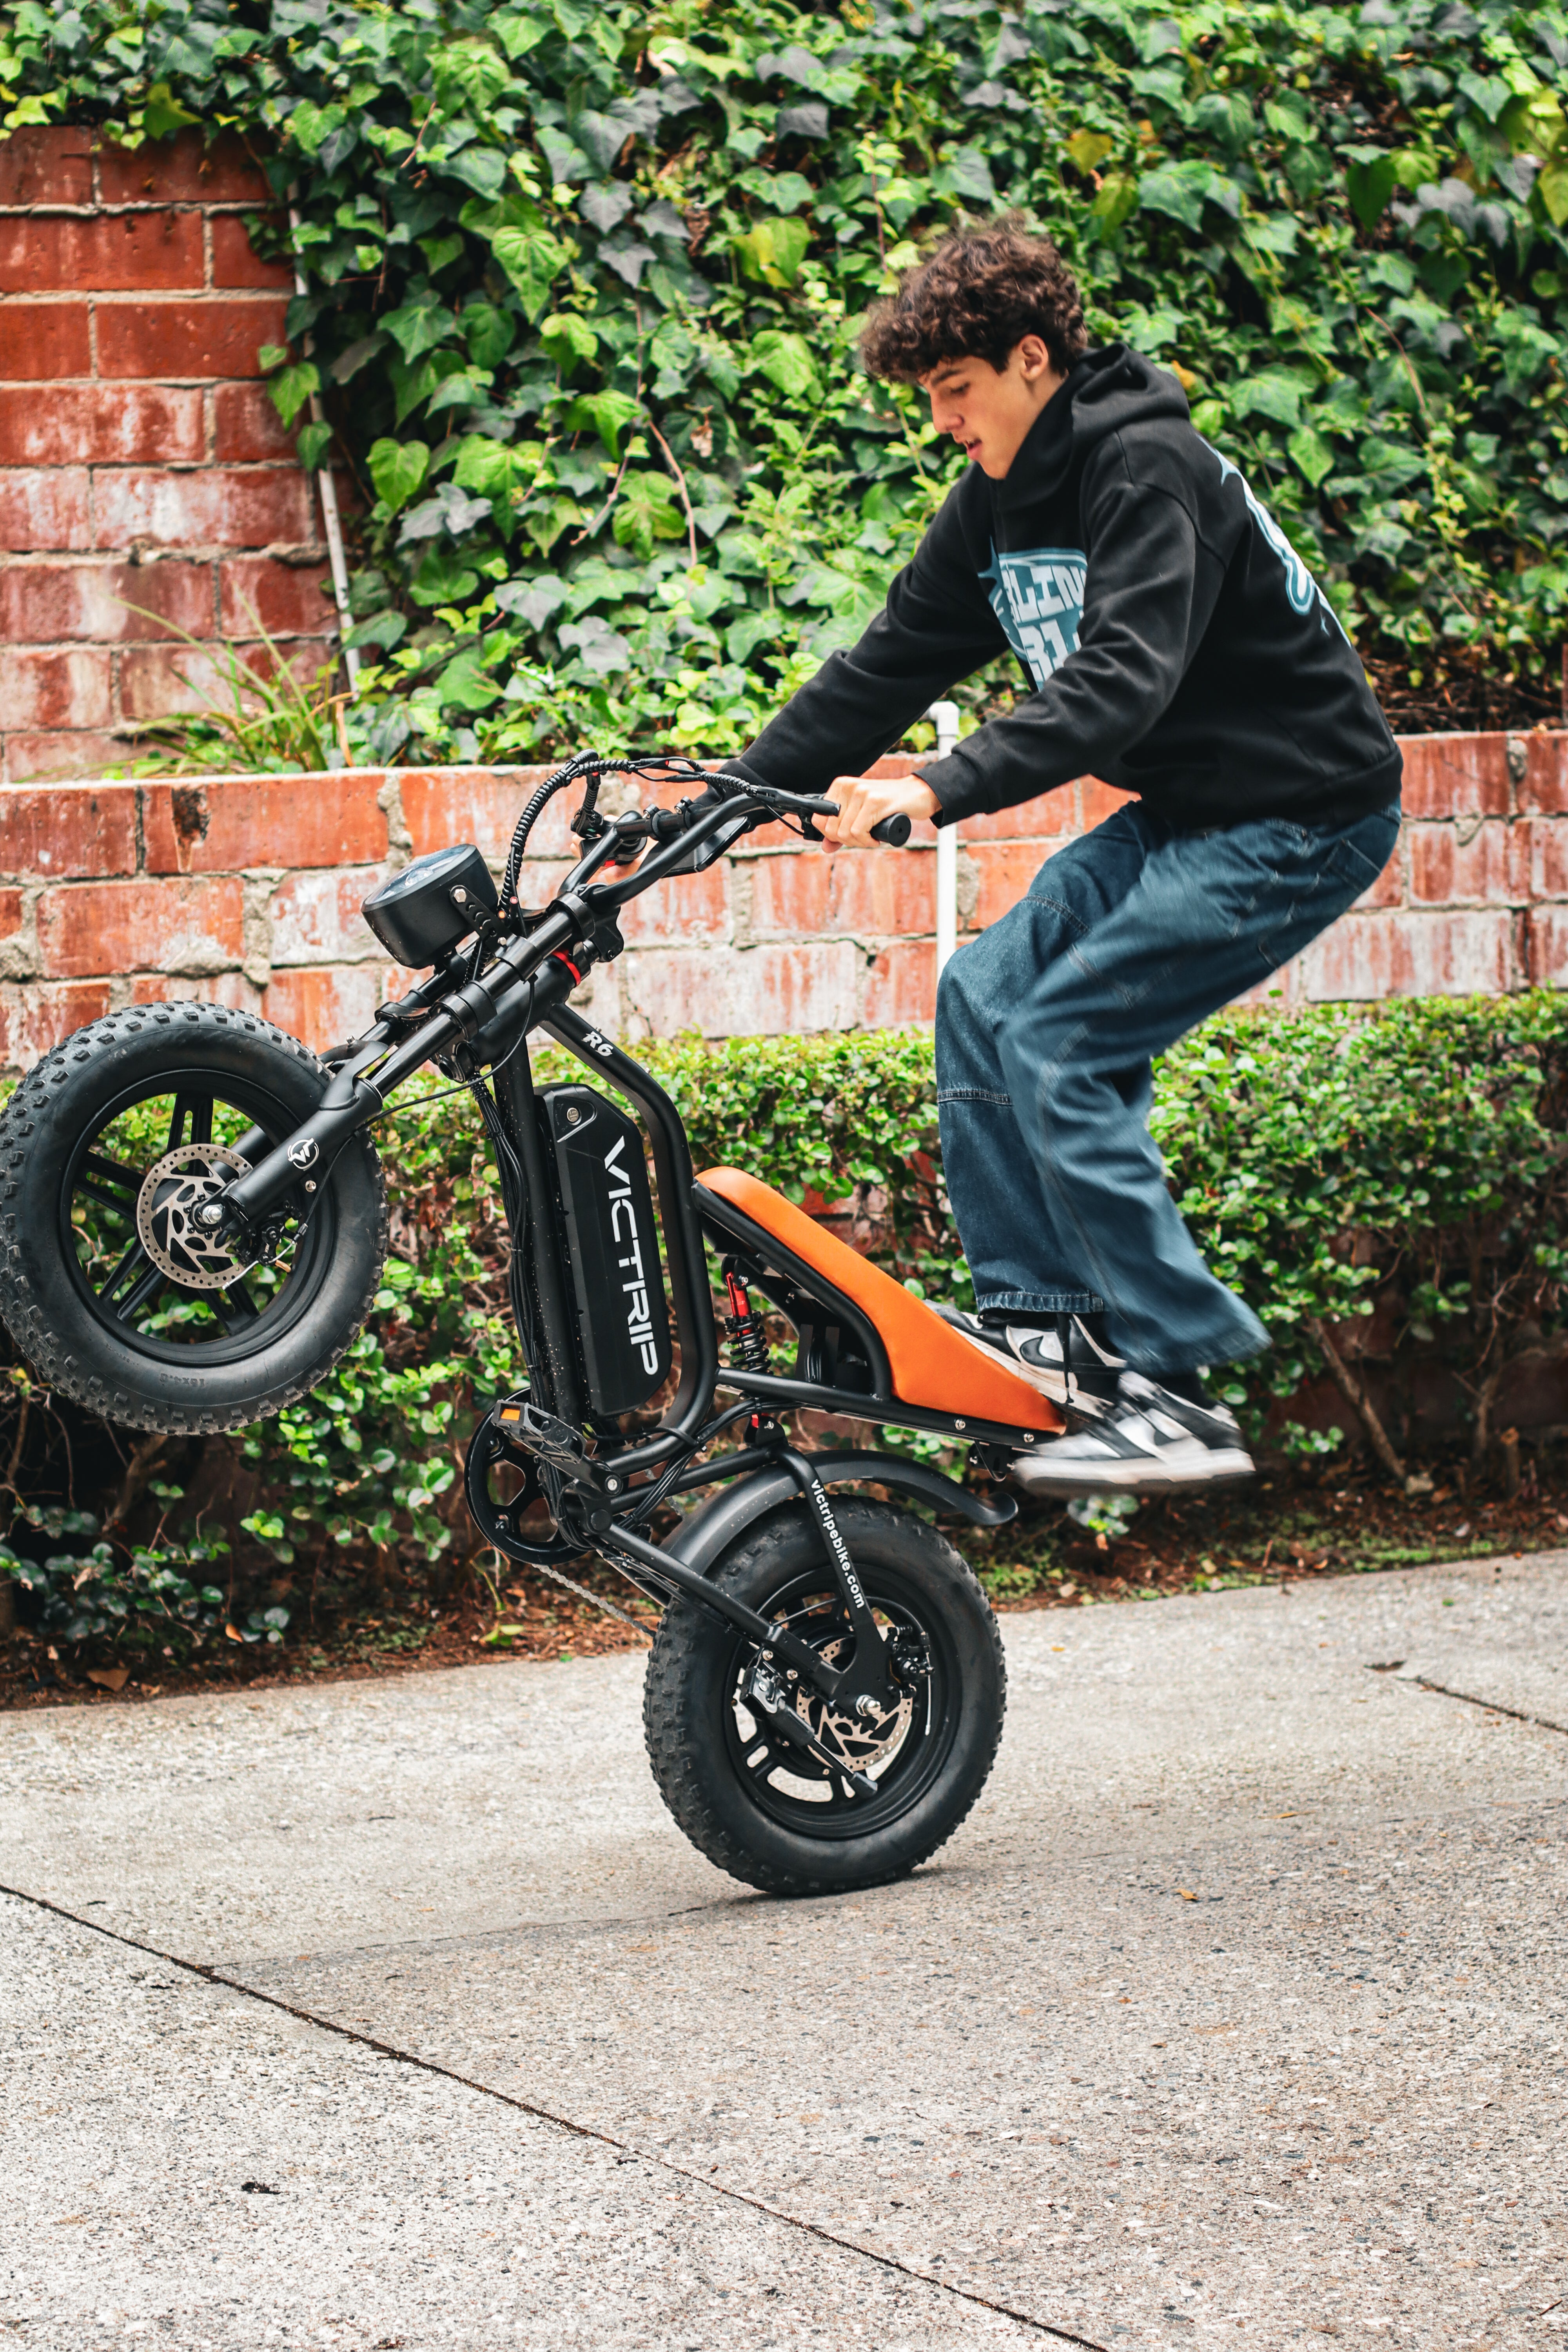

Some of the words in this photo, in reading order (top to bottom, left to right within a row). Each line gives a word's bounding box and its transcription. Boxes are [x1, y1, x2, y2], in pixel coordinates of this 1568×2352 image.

[581, 1031, 613, 1056] R6
[604, 1135, 658, 1375] VICTRIP
[811, 1479, 865, 1608] victripebike.com
